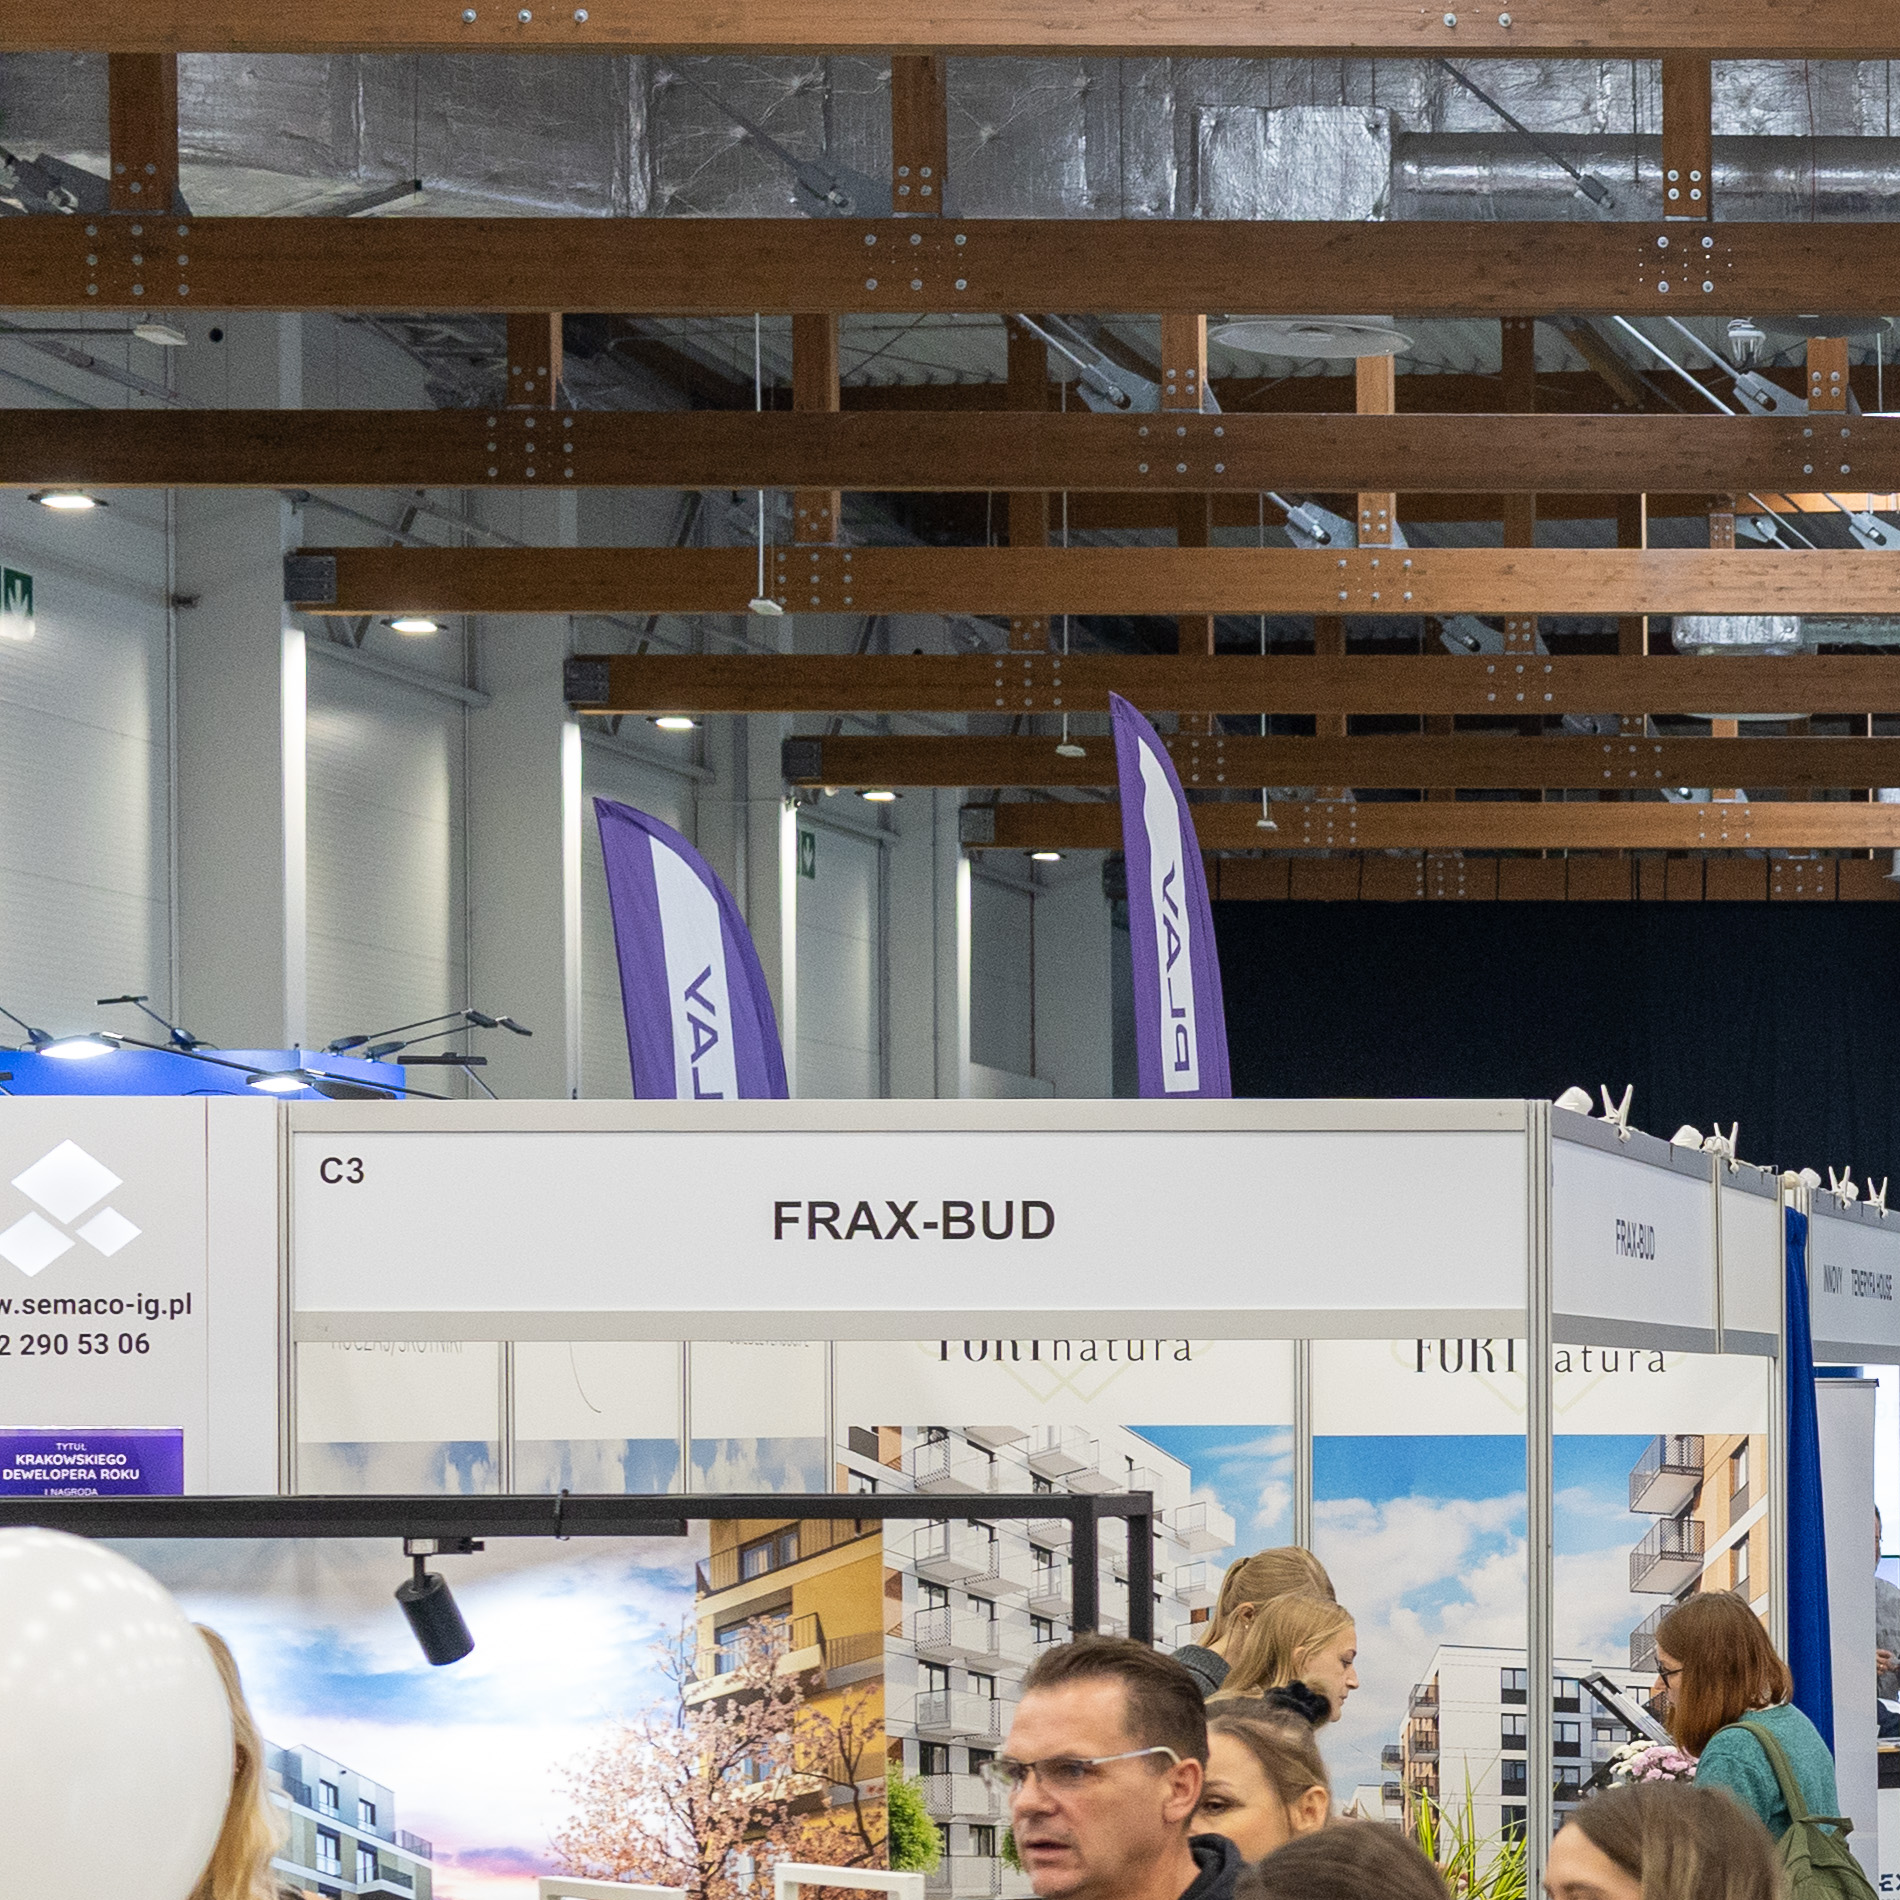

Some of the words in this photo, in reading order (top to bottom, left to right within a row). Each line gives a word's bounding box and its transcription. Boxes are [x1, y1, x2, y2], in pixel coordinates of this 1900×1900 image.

[319, 1157, 365, 1185] C3
[773, 1199, 1056, 1241] FRAX-BUD
[1615, 1218, 1656, 1261] FRAX-BUD
[20, 1334, 69, 1356] 290
[77, 1333, 110, 1355] 53
[118, 1332, 151, 1355] 06
[15, 1453, 128, 1466] KRAKOWSKIEGO
[2, 1468, 98, 1481] DEWELOPERA
[100, 1468, 141, 1481] ROKU
[50, 1487, 99, 1496] NAGRODA
